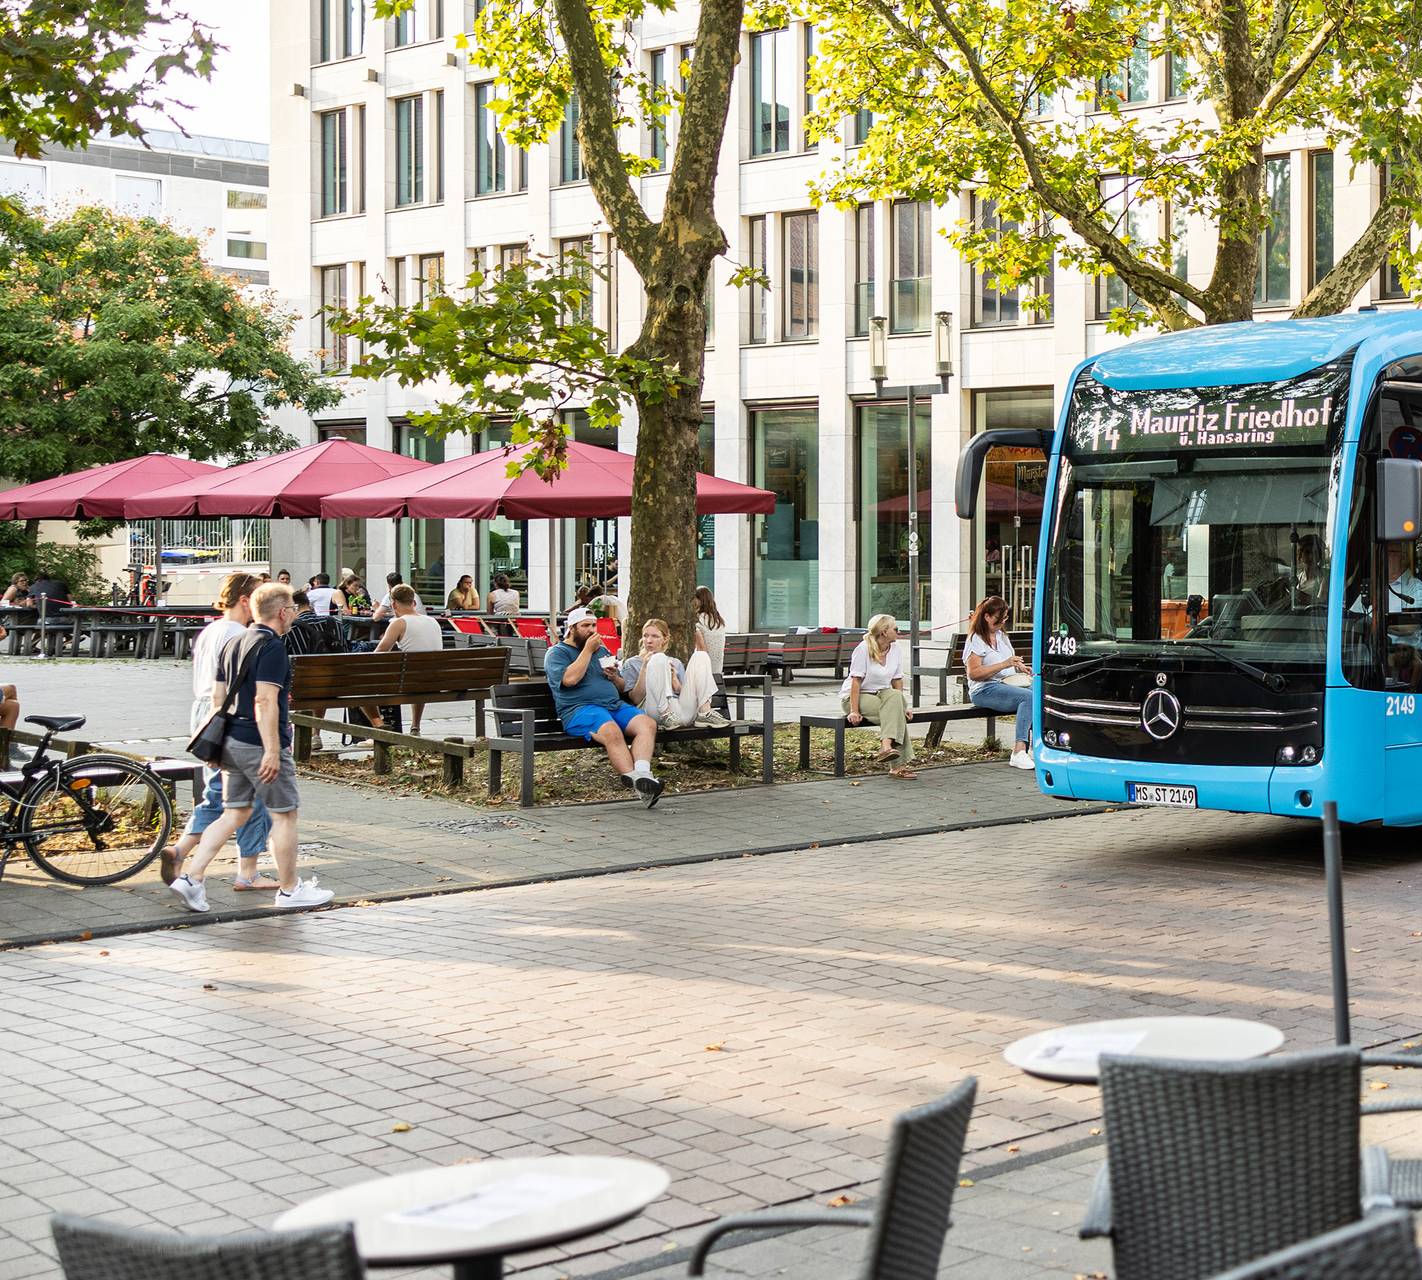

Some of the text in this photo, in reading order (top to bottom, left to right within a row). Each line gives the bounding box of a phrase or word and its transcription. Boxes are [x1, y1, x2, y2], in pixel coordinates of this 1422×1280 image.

[1091, 396, 1333, 452] 14 Mauritz Friedhof
[1197, 430, 1275, 446] Hansaring
[1048, 636, 1076, 655] 2149
[1386, 695, 1415, 716] 2149
[1135, 783, 1194, 804] MS ST 2149
